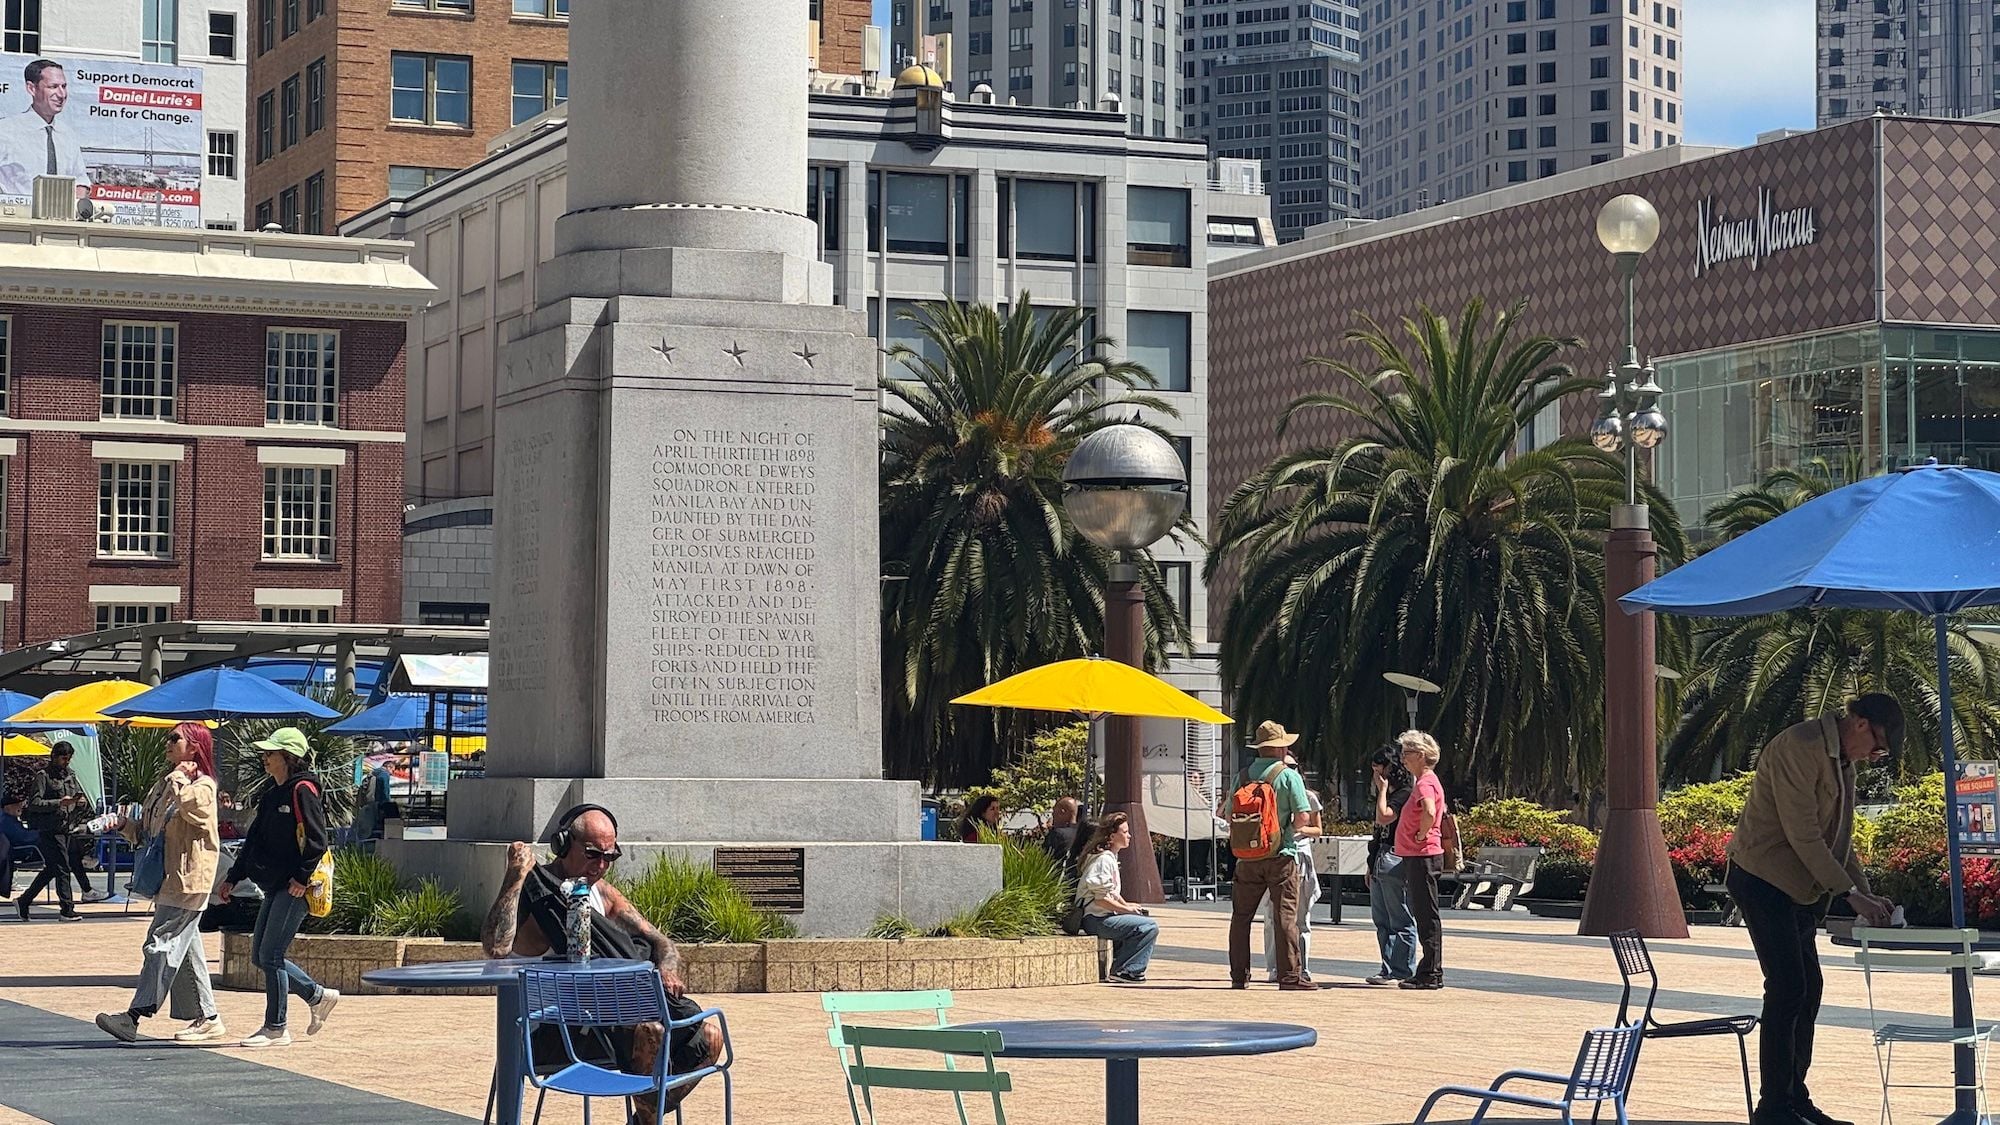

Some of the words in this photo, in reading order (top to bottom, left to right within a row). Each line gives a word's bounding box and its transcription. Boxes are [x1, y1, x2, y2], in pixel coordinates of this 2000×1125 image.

[77, 69, 129, 84] Support
[132, 74, 195, 89] Democrat
[0, 83, 9, 94] F
[103, 89, 147, 104] Daniel
[149, 93, 194, 107] Lurie's
[90, 106, 118, 119] Plan
[121, 107, 138, 120] for
[141, 109, 194, 125] Change.
[1693, 194, 1755, 278] Neiman
[1751, 185, 1816, 272] Marcus
[674, 429, 696, 442] ON
[703, 430, 734, 443] THE
[740, 431, 790, 445] NIGHT
[795, 433, 815, 446] OF
[653, 445, 698, 459] APRIL
[702, 446, 779, 461] THIRTIETH
[785, 449, 815, 462] 1898
[652, 462, 752, 477] COMMODORE
[653, 478, 738, 493] SQUADRON
[747, 481, 815, 495] ENTERED
[652, 495, 714, 508] MANILA
[719, 497, 747, 509] BAY
[751, 498, 785, 510] AND
[652, 511, 721, 525] DAUNTED
[727, 513, 744, 526] BY
[749, 514, 776, 527] THE
[652, 527, 685, 541] GER
[692, 528, 713, 541] OF
[719, 529, 815, 544] SUBMERGED
[652, 544, 741, 559] EXPLOSIVES
[746, 546, 815, 560] REACHED
[652, 561, 713, 575] MANILA
[721, 562, 739, 575] AT
[744, 563, 789, 576] DAWN
[795, 564, 815, 577] OF
[652, 577, 689, 591] MAY
[701, 578, 755, 592] FIRST
[652, 594, 739, 608] ATTACKED
[747, 595, 784, 609] AND
[652, 610, 721, 624] STROYED
[727, 612, 753, 625] THE
[757, 612, 816, 626] SPANISH
[652, 627, 701, 640] FLEET
[708, 627, 729, 640] OF
[737, 628, 769, 641] TEN
[777, 629, 814, 642] WAR
[705, 644, 779, 658] REDUCED
[785, 645, 816, 658] THE
[652, 660, 698, 673] FORTS
[702, 661, 736, 674] AND
[741, 661, 781, 675] HELD
[785, 662, 816, 675] THE
[652, 676, 687, 690] CITY
[693, 677, 709, 690] IN
[718, 677, 815, 691] SUBJECTION
[652, 693, 694, 706] UNTIL
[700, 693, 727, 706] THE
[731, 694, 792, 707] ARRIVAL
[797, 695, 814, 707] OF
[653, 710, 709, 723] TROOPS
[713, 710, 751, 723] FROM
[755, 711, 815, 724] AMERICA
